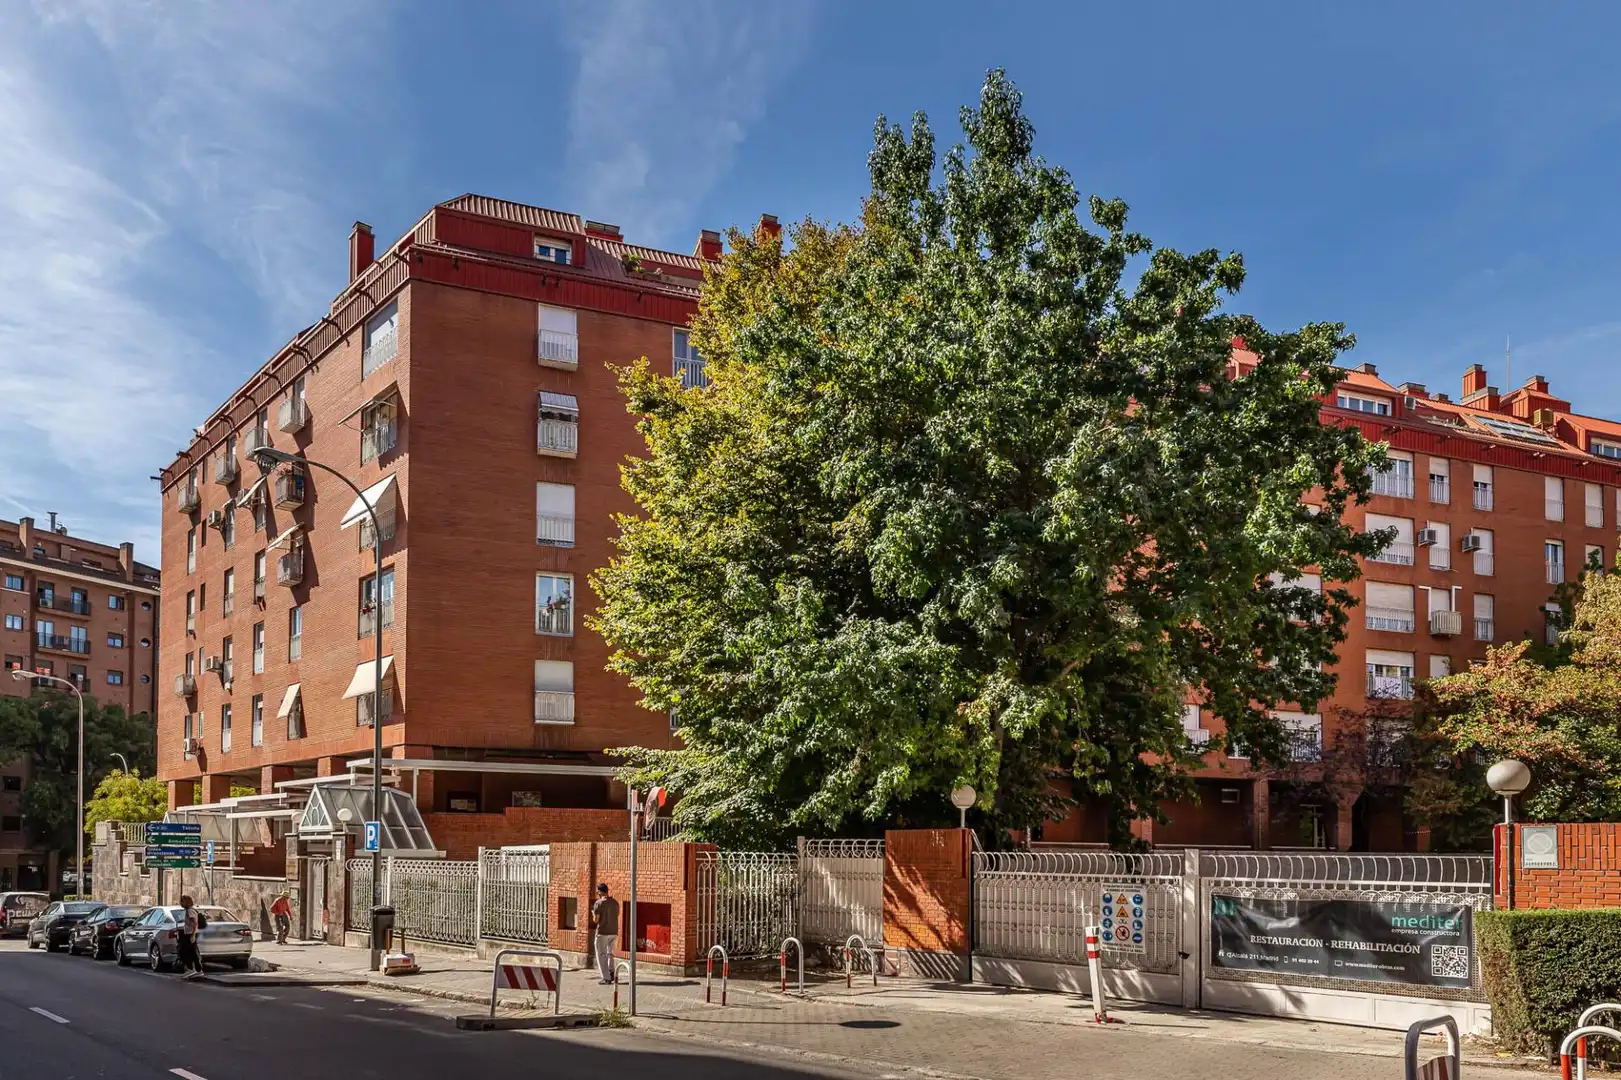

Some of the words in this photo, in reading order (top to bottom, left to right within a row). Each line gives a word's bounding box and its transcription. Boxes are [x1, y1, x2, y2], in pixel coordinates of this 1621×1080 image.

[366, 825, 376, 849] P
[1391, 914, 1463, 930] mediter
[1391, 928, 1419, 936] empresa
[1331, 940, 1421, 954] REHABILITACIÓN
